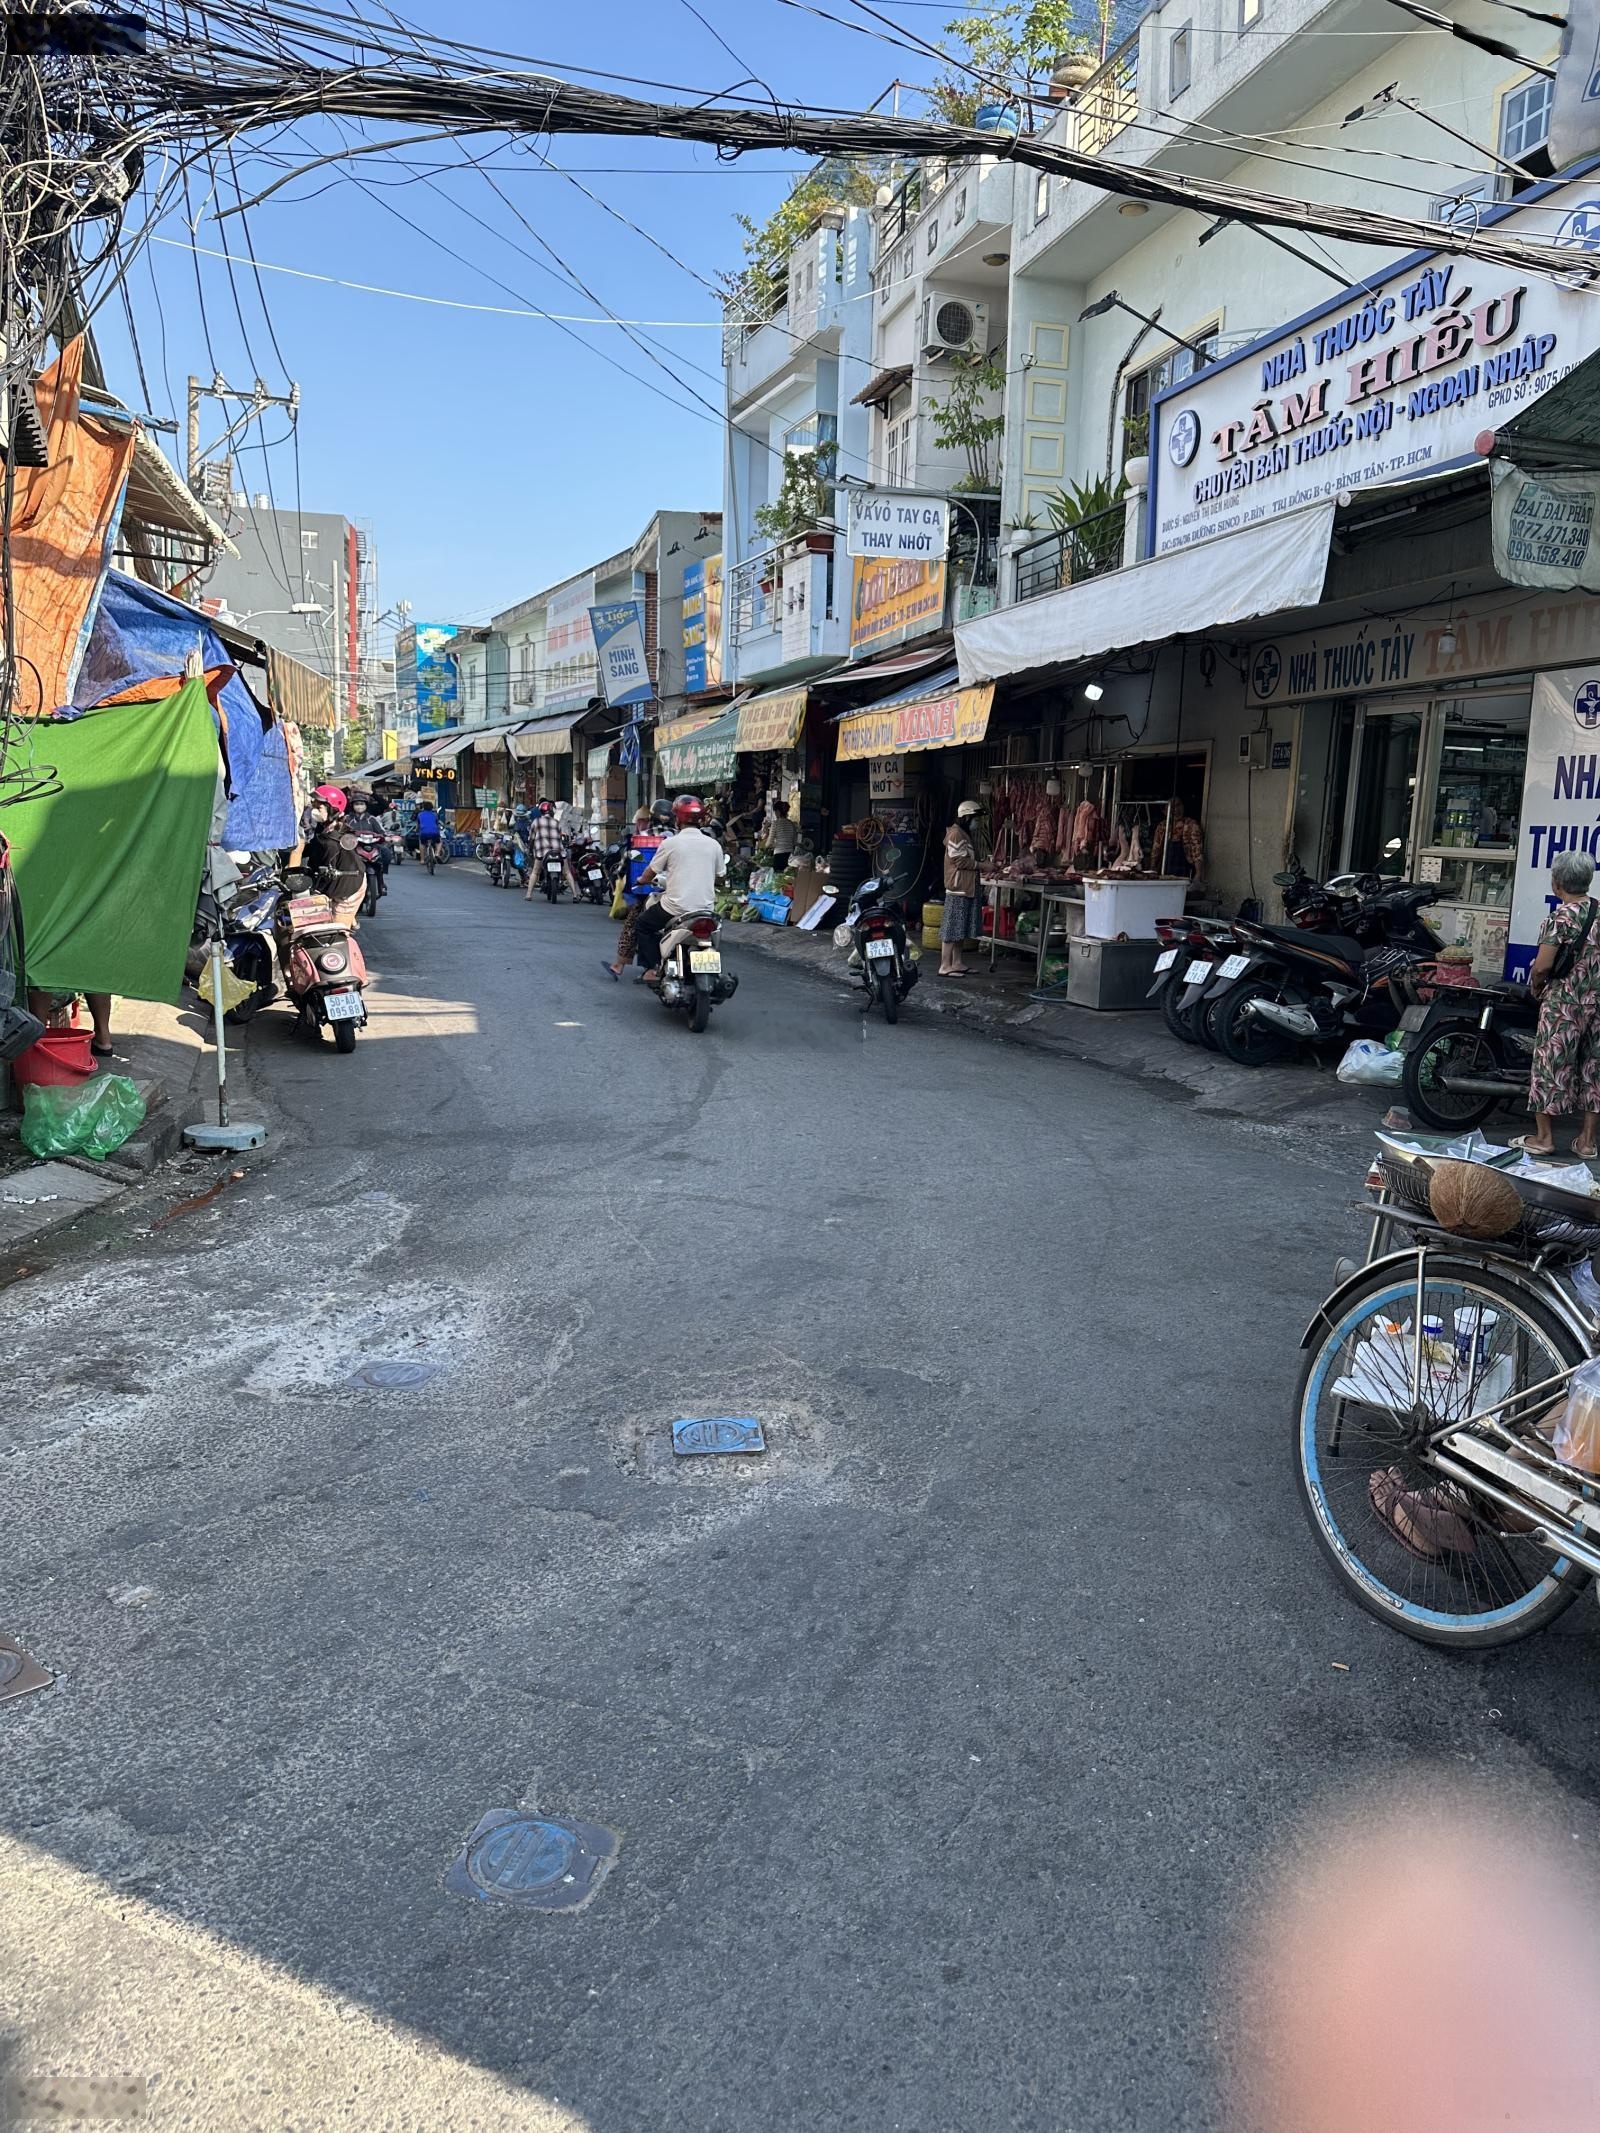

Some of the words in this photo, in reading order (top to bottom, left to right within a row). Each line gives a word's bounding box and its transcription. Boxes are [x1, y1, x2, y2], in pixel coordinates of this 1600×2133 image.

[1261, 336, 1306, 391] NHÀ
[1312, 290, 1396, 365] THUỐC
[1401, 265, 1454, 321] TÂY
[1211, 379, 1331, 462] TÂM
[1345, 286, 1527, 405] HIẾU
[1488, 387, 1512, 408] GPKD
[1193, 459, 1253, 504] CHUYÊN
[1255, 443, 1289, 481] BÁN
[1292, 411, 1353, 465] THUỐC
[1356, 398, 1393, 441] NỘI
[1408, 365, 1479, 421] NGOẠI
[1483, 333, 1557, 390] NHẬP
[897, 508, 920, 524] TAY
[923, 509, 940, 525] GA
[862, 532, 893, 548] THAY
[899, 532, 932, 551] NHỚT
[605, 608, 635, 624] Tiger
[608, 647, 636, 664] MINH
[1288, 640, 1317, 695] NHÀ
[1323, 624, 1376, 690] THUỐC
[1381, 624, 1415, 682] TÂY
[1423, 609, 1513, 675] TÂM
[610, 662, 639, 677] SANG
[896, 699, 958, 744] MINH
[1553, 754, 1600, 800] NH
